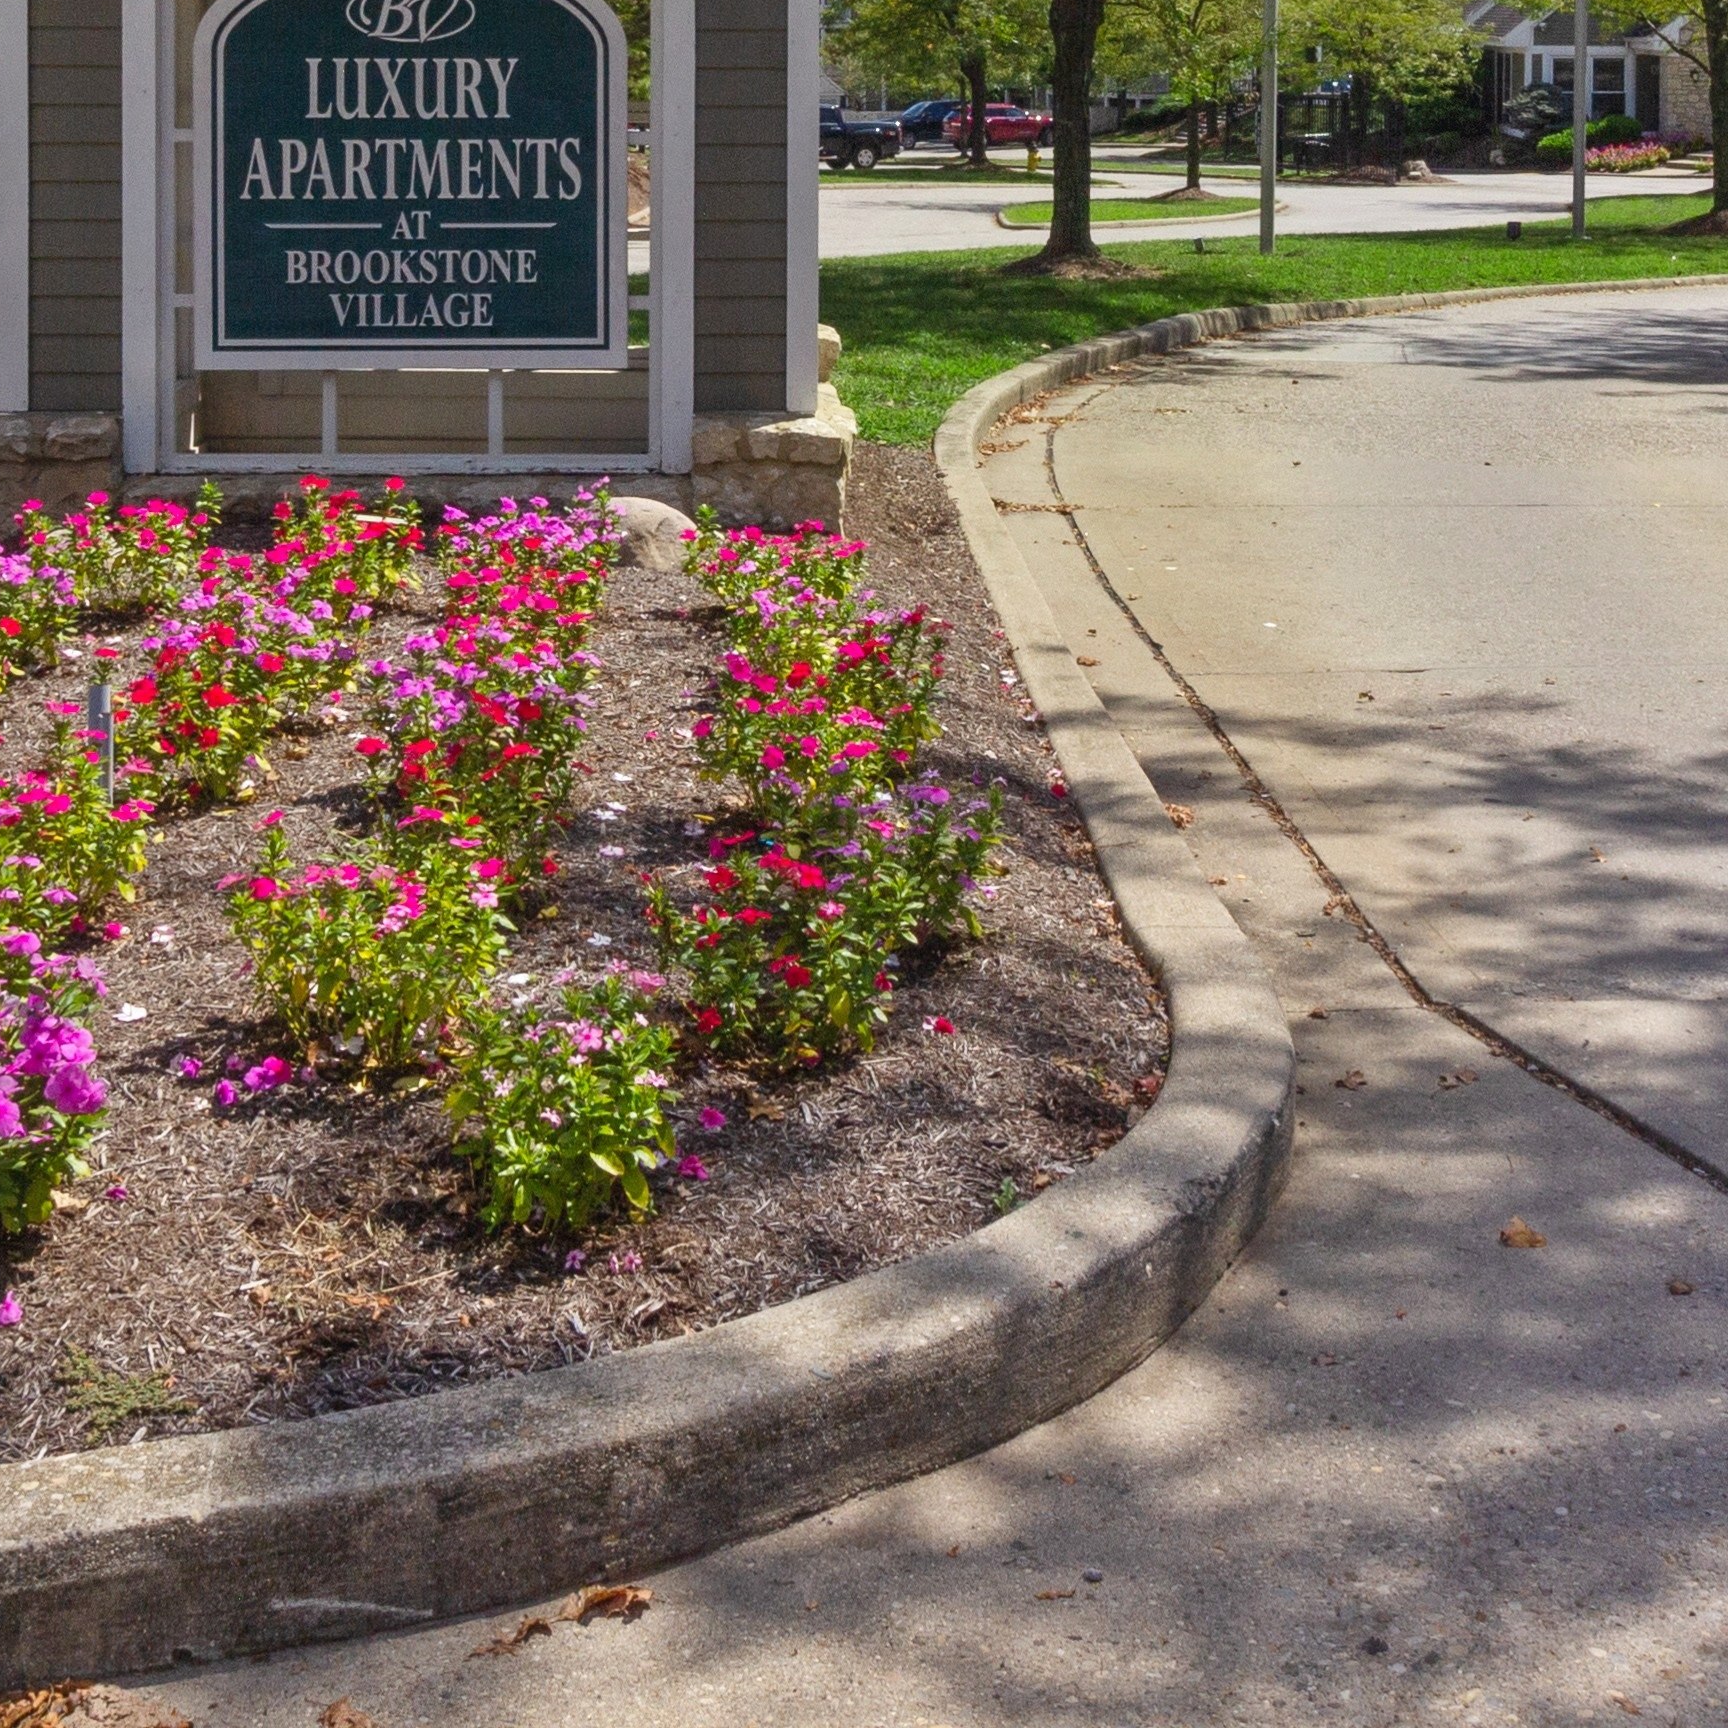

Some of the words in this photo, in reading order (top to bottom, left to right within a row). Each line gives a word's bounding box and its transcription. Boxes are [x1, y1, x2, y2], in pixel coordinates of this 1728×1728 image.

[305, 57, 519, 120] LUXURY
[239, 137, 582, 201] APARTMENTS
[391, 210, 431, 241] AT
[284, 250, 538, 284] BROOKSTONE
[329, 293, 493, 327] VILLAGE
